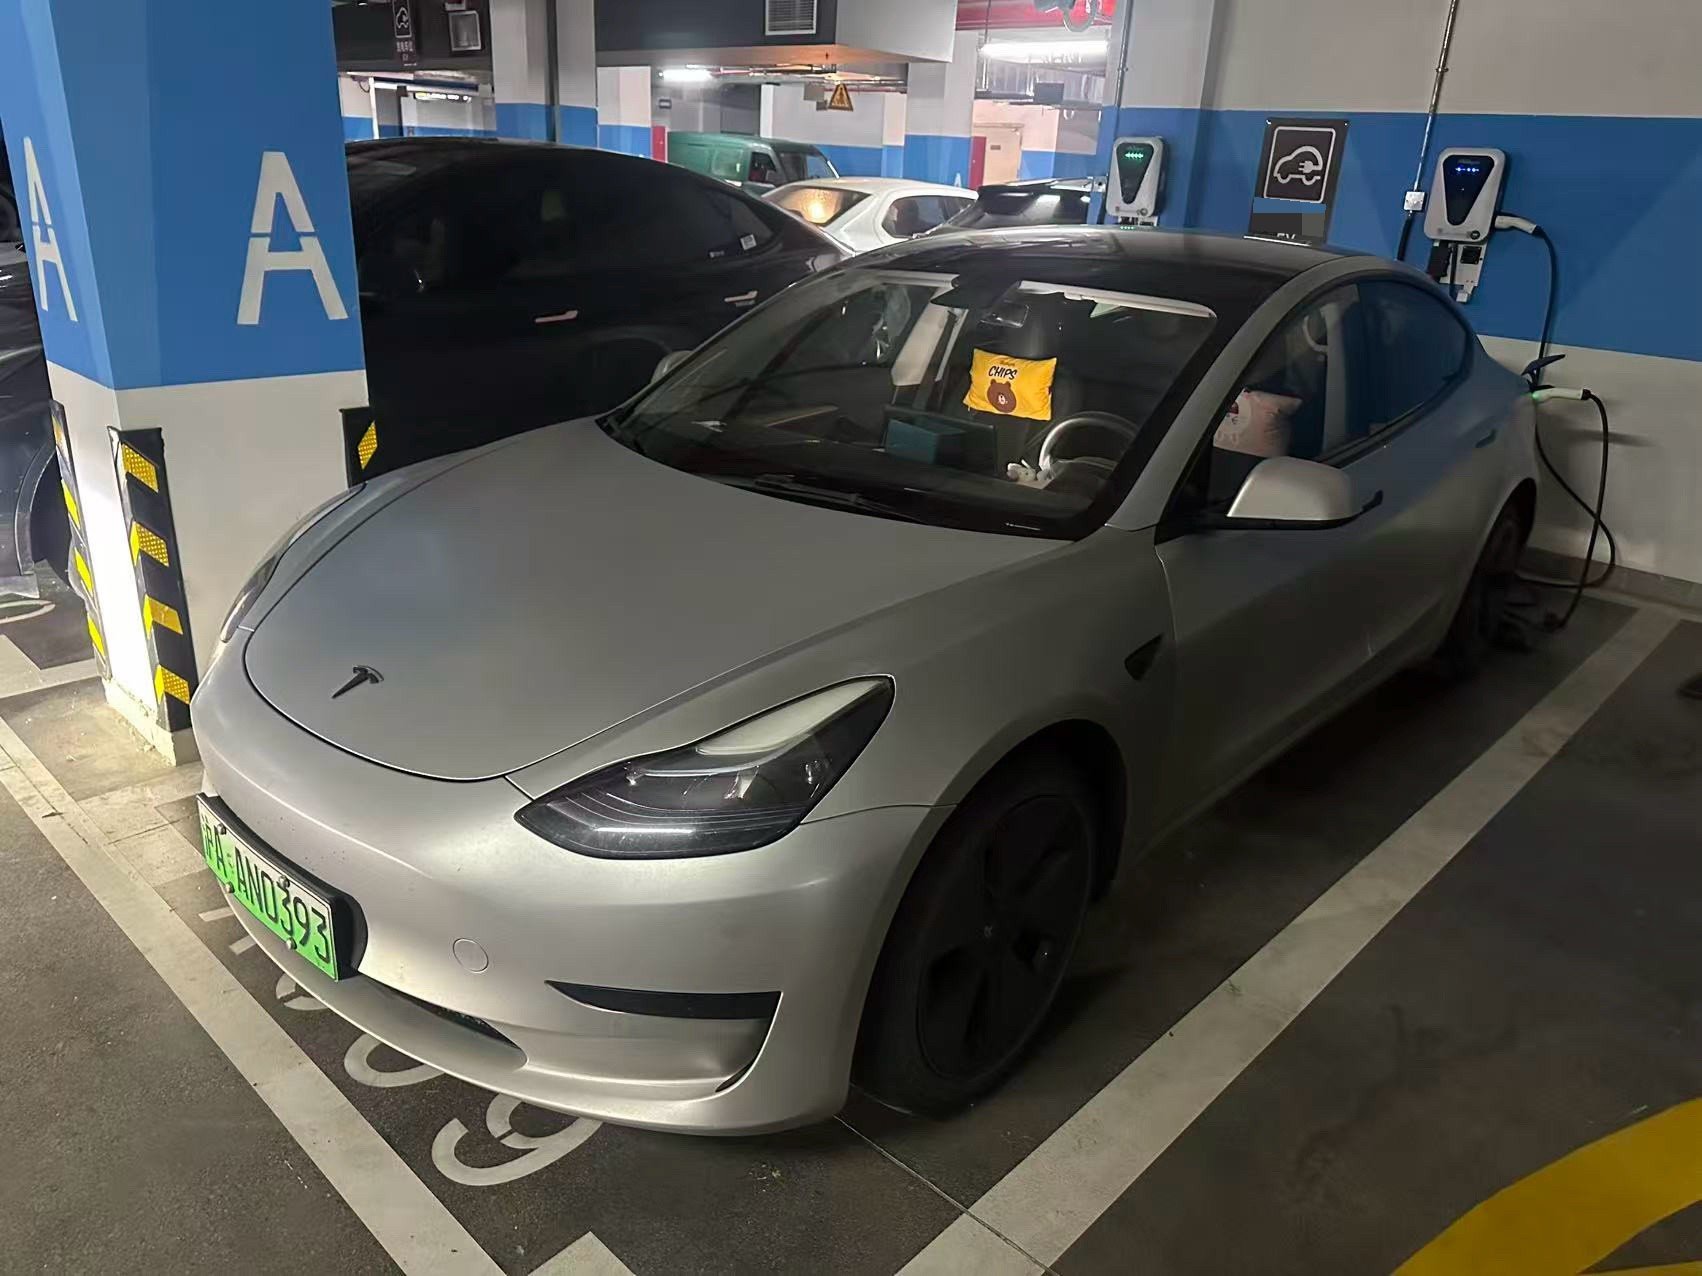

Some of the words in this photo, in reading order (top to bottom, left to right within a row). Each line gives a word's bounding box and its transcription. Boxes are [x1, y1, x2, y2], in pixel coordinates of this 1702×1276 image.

[23, 136, 78, 322] A
[237, 151, 348, 325] A
[988, 365, 1018, 380] CHIPS
